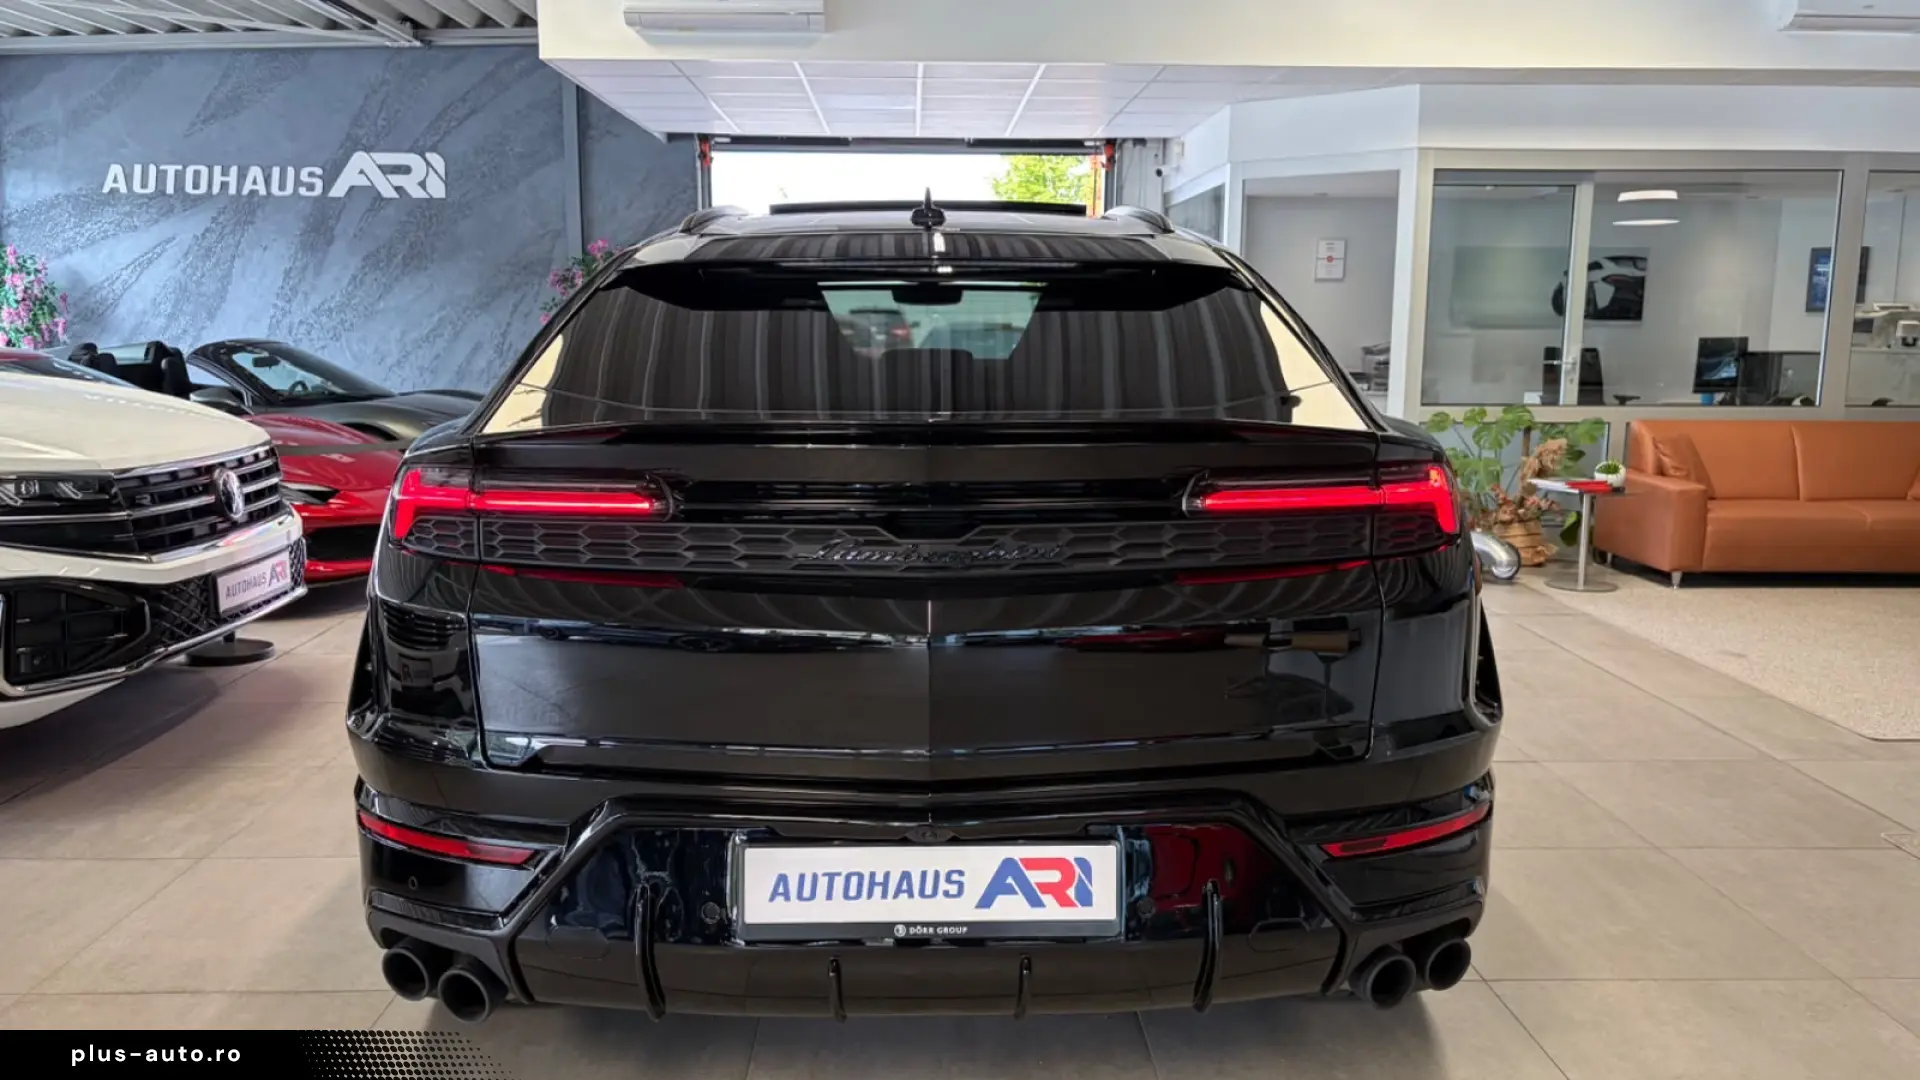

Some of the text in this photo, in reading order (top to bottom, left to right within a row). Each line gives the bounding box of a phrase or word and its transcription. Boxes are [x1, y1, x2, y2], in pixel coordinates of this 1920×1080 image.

[101, 150, 447, 199] AUTOHAUS ARI
[225, 571, 268, 600] AUTOHAUS
[768, 856, 1094, 910] AUTOHAUS ARI
[936, 925, 968, 935] GROUP
